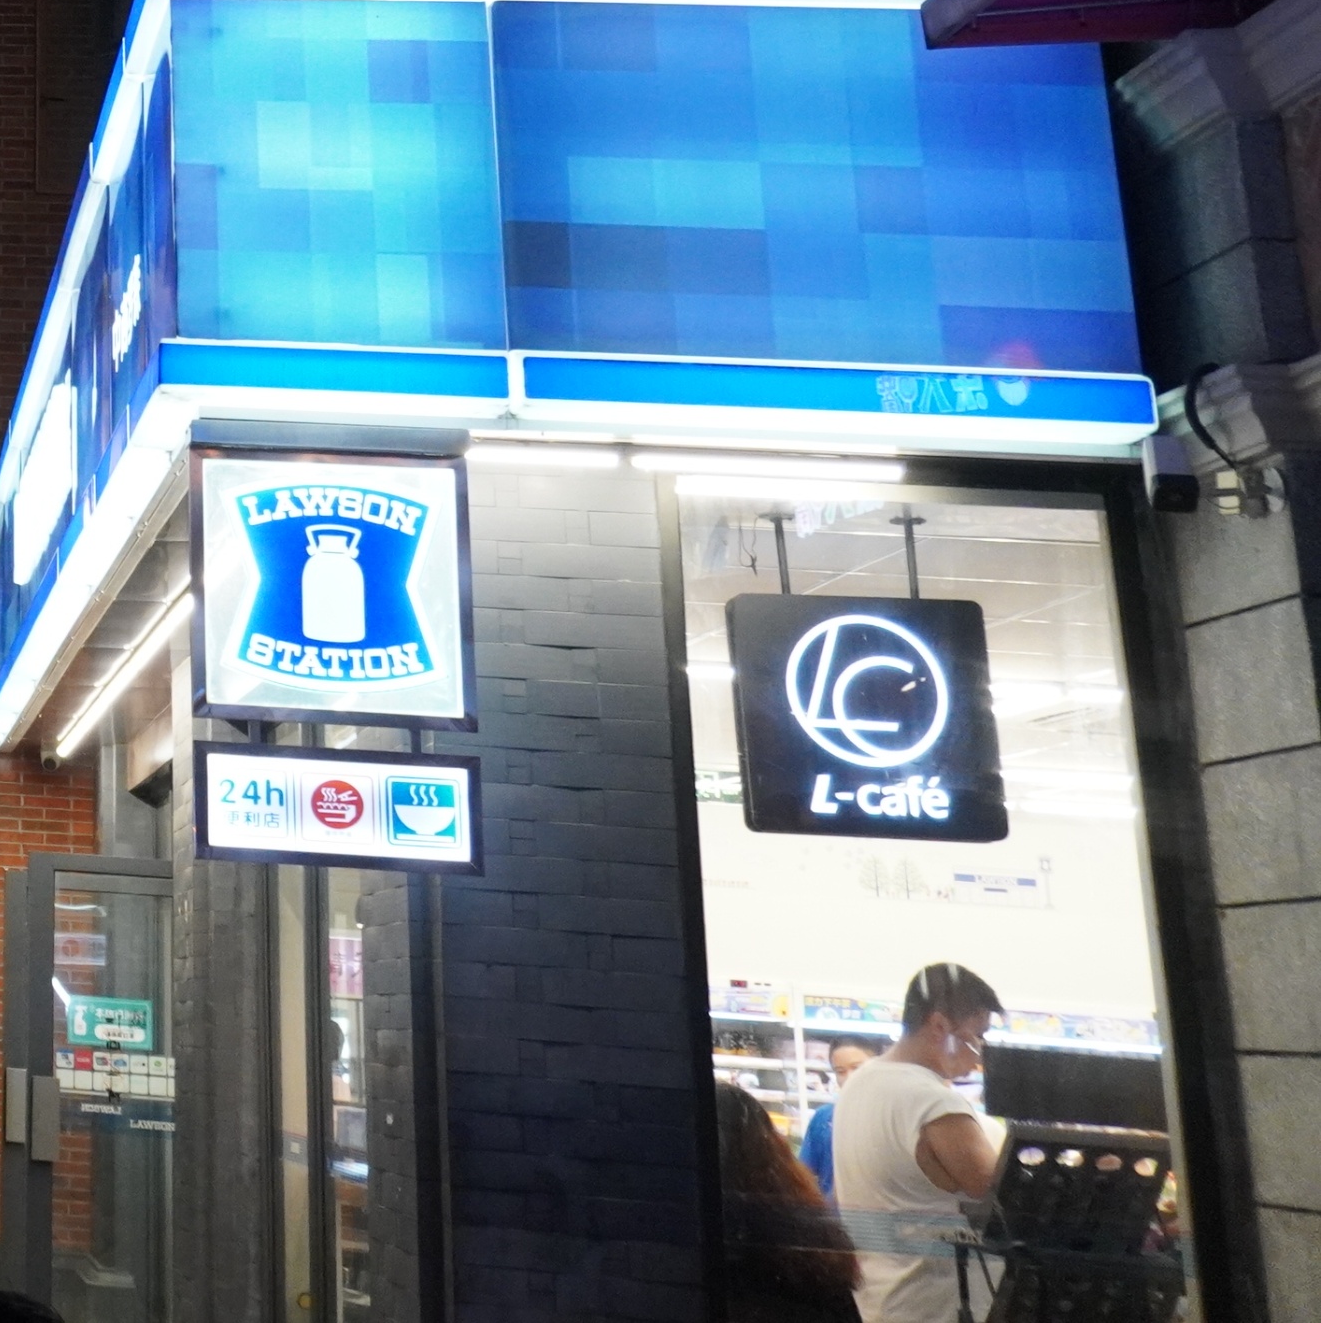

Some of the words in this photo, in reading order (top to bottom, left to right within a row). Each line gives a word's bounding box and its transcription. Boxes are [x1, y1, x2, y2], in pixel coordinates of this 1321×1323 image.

[242, 487, 422, 536] LAWSON
[246, 632, 425, 679] STATION
[219, 779, 285, 807] 24h
[810, 774, 950, 819] L-café
